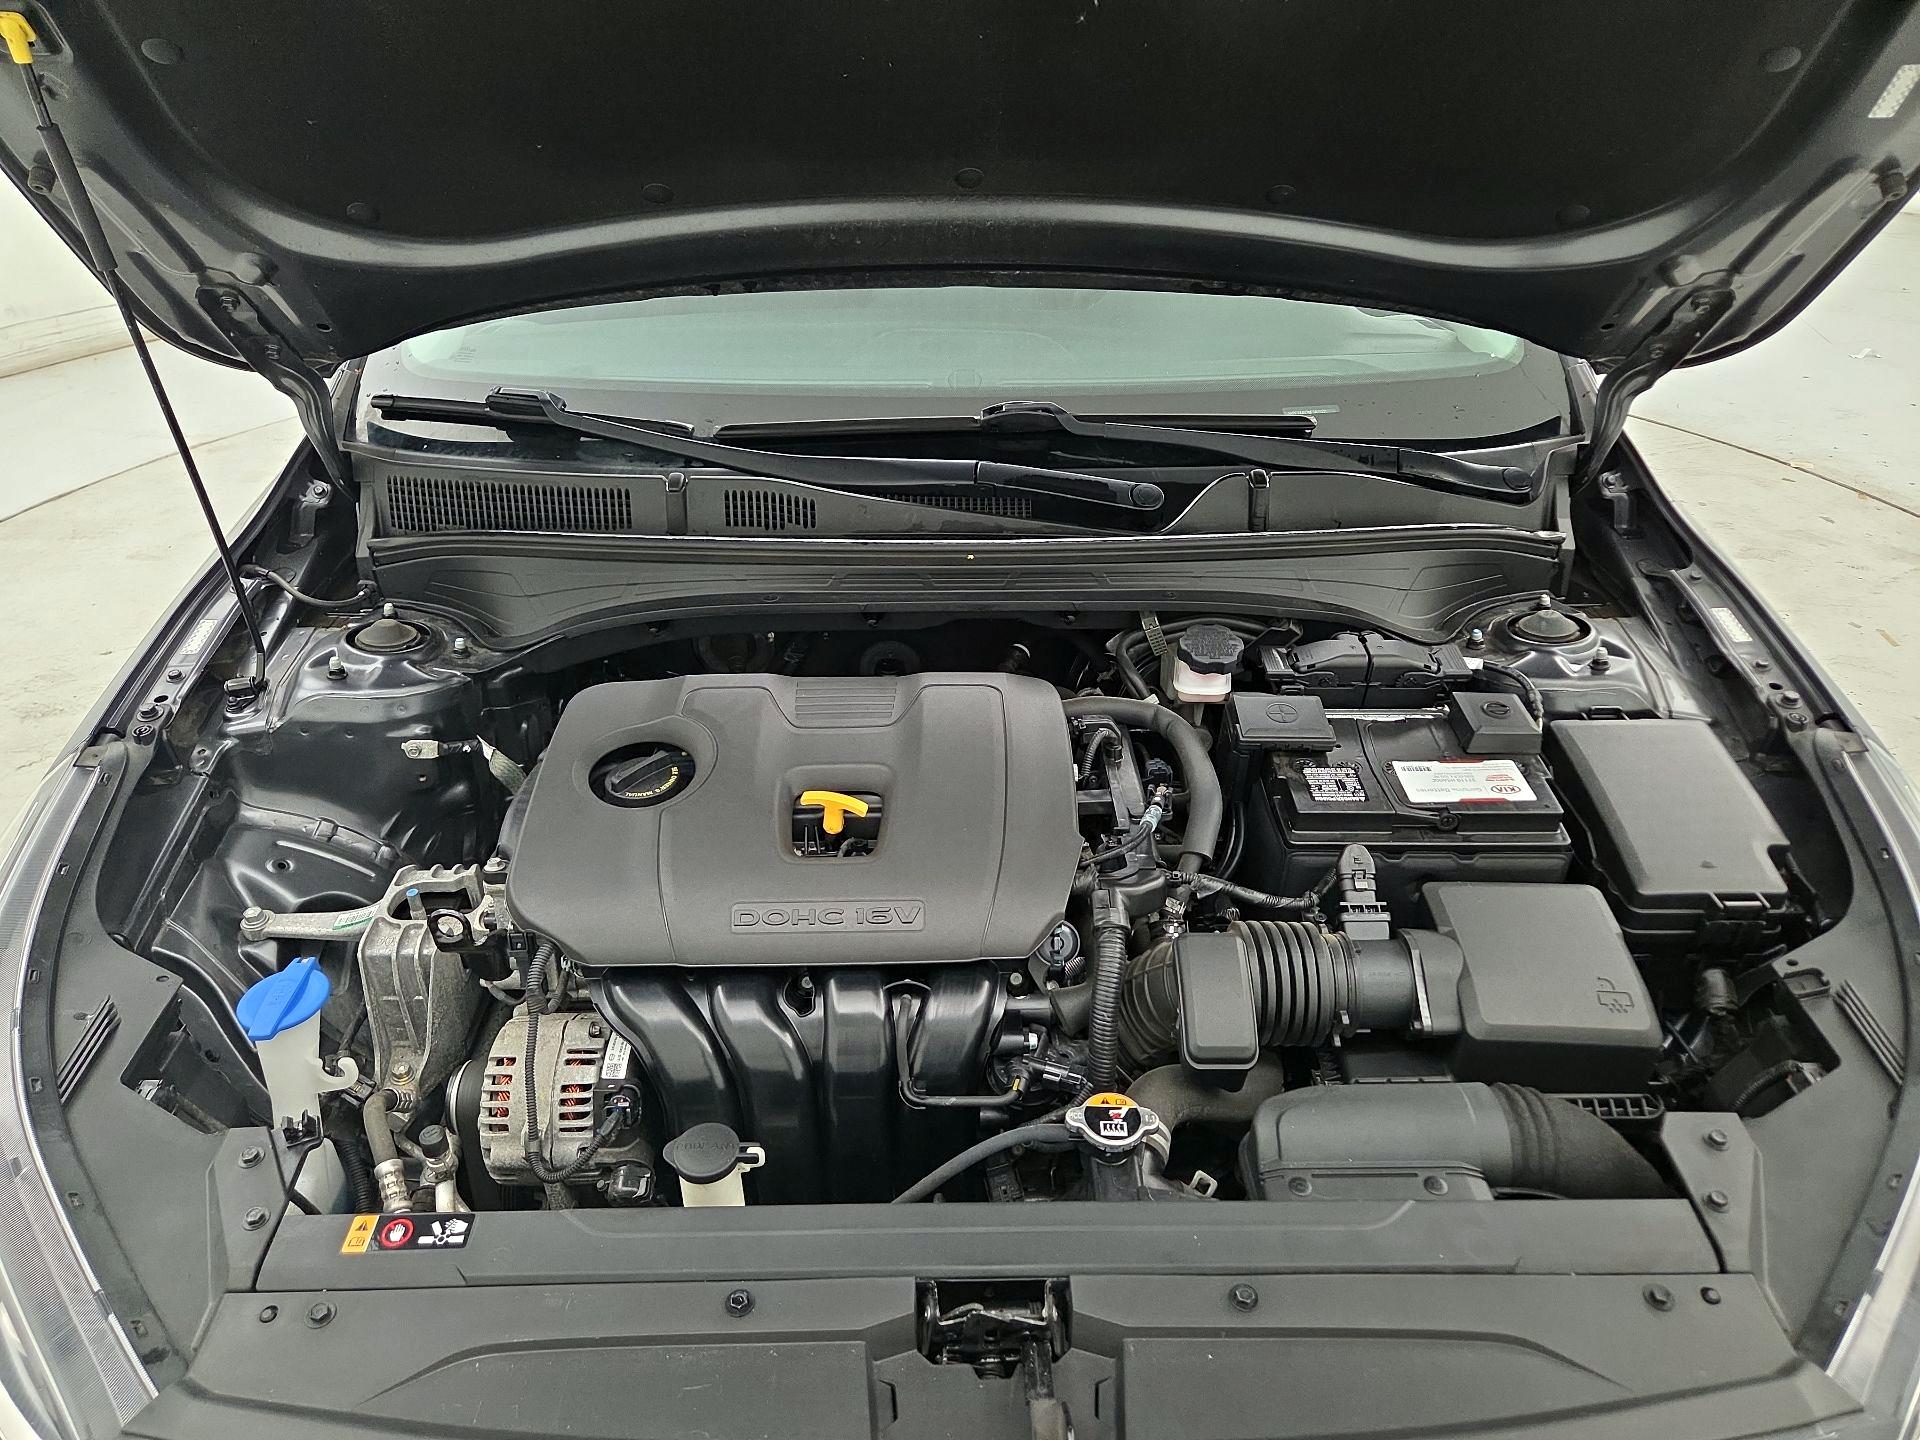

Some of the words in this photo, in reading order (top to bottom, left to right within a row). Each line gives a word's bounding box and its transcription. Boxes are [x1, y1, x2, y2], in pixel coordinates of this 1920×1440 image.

[1493, 785, 1519, 793] KIA
[733, 908, 845, 927] DOHC
[855, 906, 922, 925] 16V
